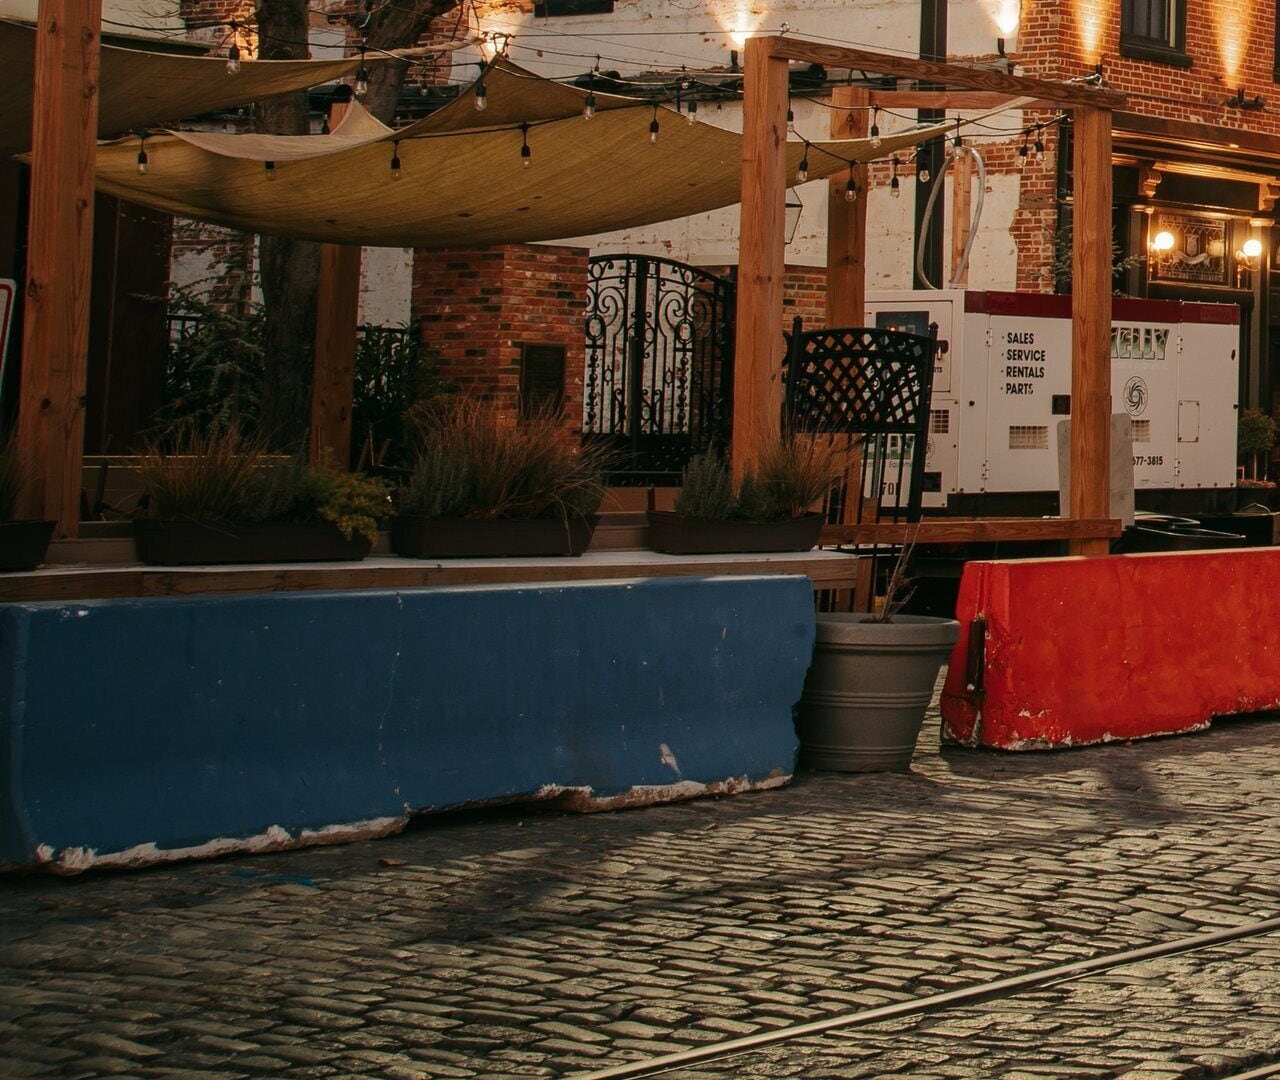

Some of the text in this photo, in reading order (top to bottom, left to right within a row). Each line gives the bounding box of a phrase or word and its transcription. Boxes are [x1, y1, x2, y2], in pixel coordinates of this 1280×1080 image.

[1007, 332, 1035, 345] SALES
[1006, 349, 1046, 362] SERVICE
[1006, 365, 1045, 379] RENTALS
[1005, 382, 1034, 395] PARTS
